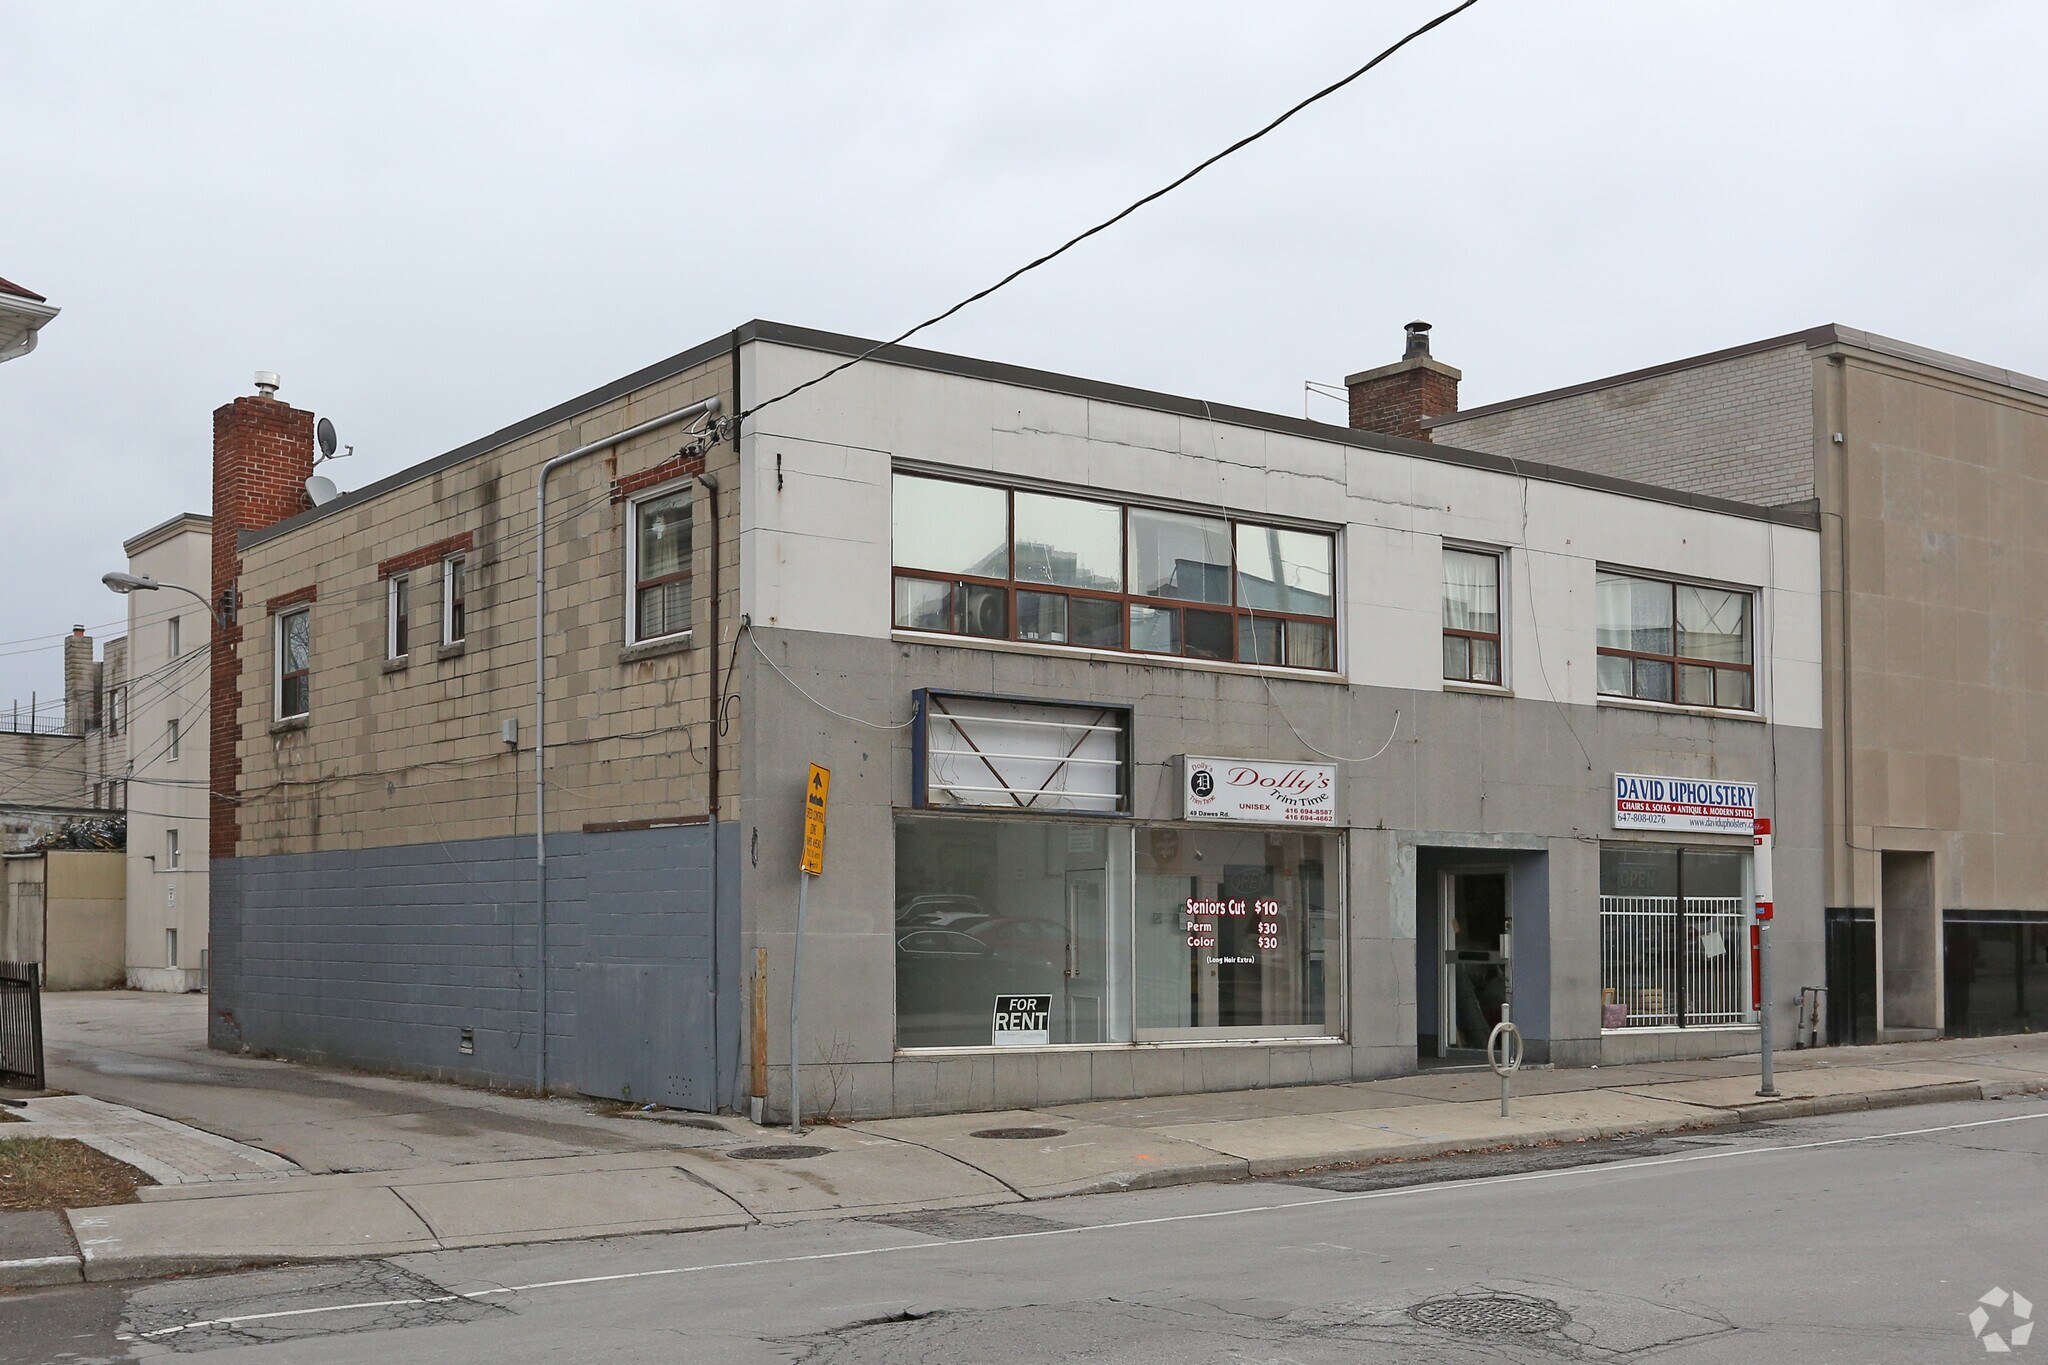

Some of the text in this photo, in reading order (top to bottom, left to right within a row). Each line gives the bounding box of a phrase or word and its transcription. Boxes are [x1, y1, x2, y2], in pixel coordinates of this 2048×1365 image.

[1191, 762, 1213, 773] Dolly's
[1226, 767, 1330, 795] Dolly's
[1270, 788, 1329, 807] Trim Time
[1617, 777, 1755, 807] DAVID UPHOLSTERY
[1239, 803, 1271, 811] UNISEX
[1621, 801, 1753, 818] CHAIRS & SOFAS ANTIQUE & MODERN STYLES
[1617, 813, 1666, 824] 647-808-0276
[1620, 870, 1655, 888] OPEN
[1186, 898, 1278, 916] Seniors Cut $10
[1187, 921, 1278, 935] Perm $30
[1187, 936, 1278, 949] Color $30
[1206, 955, 1255, 964] (Long Hair Extra)
[1009, 998, 1037, 1011] FOR
[995, 1012, 1048, 1031] RENT
